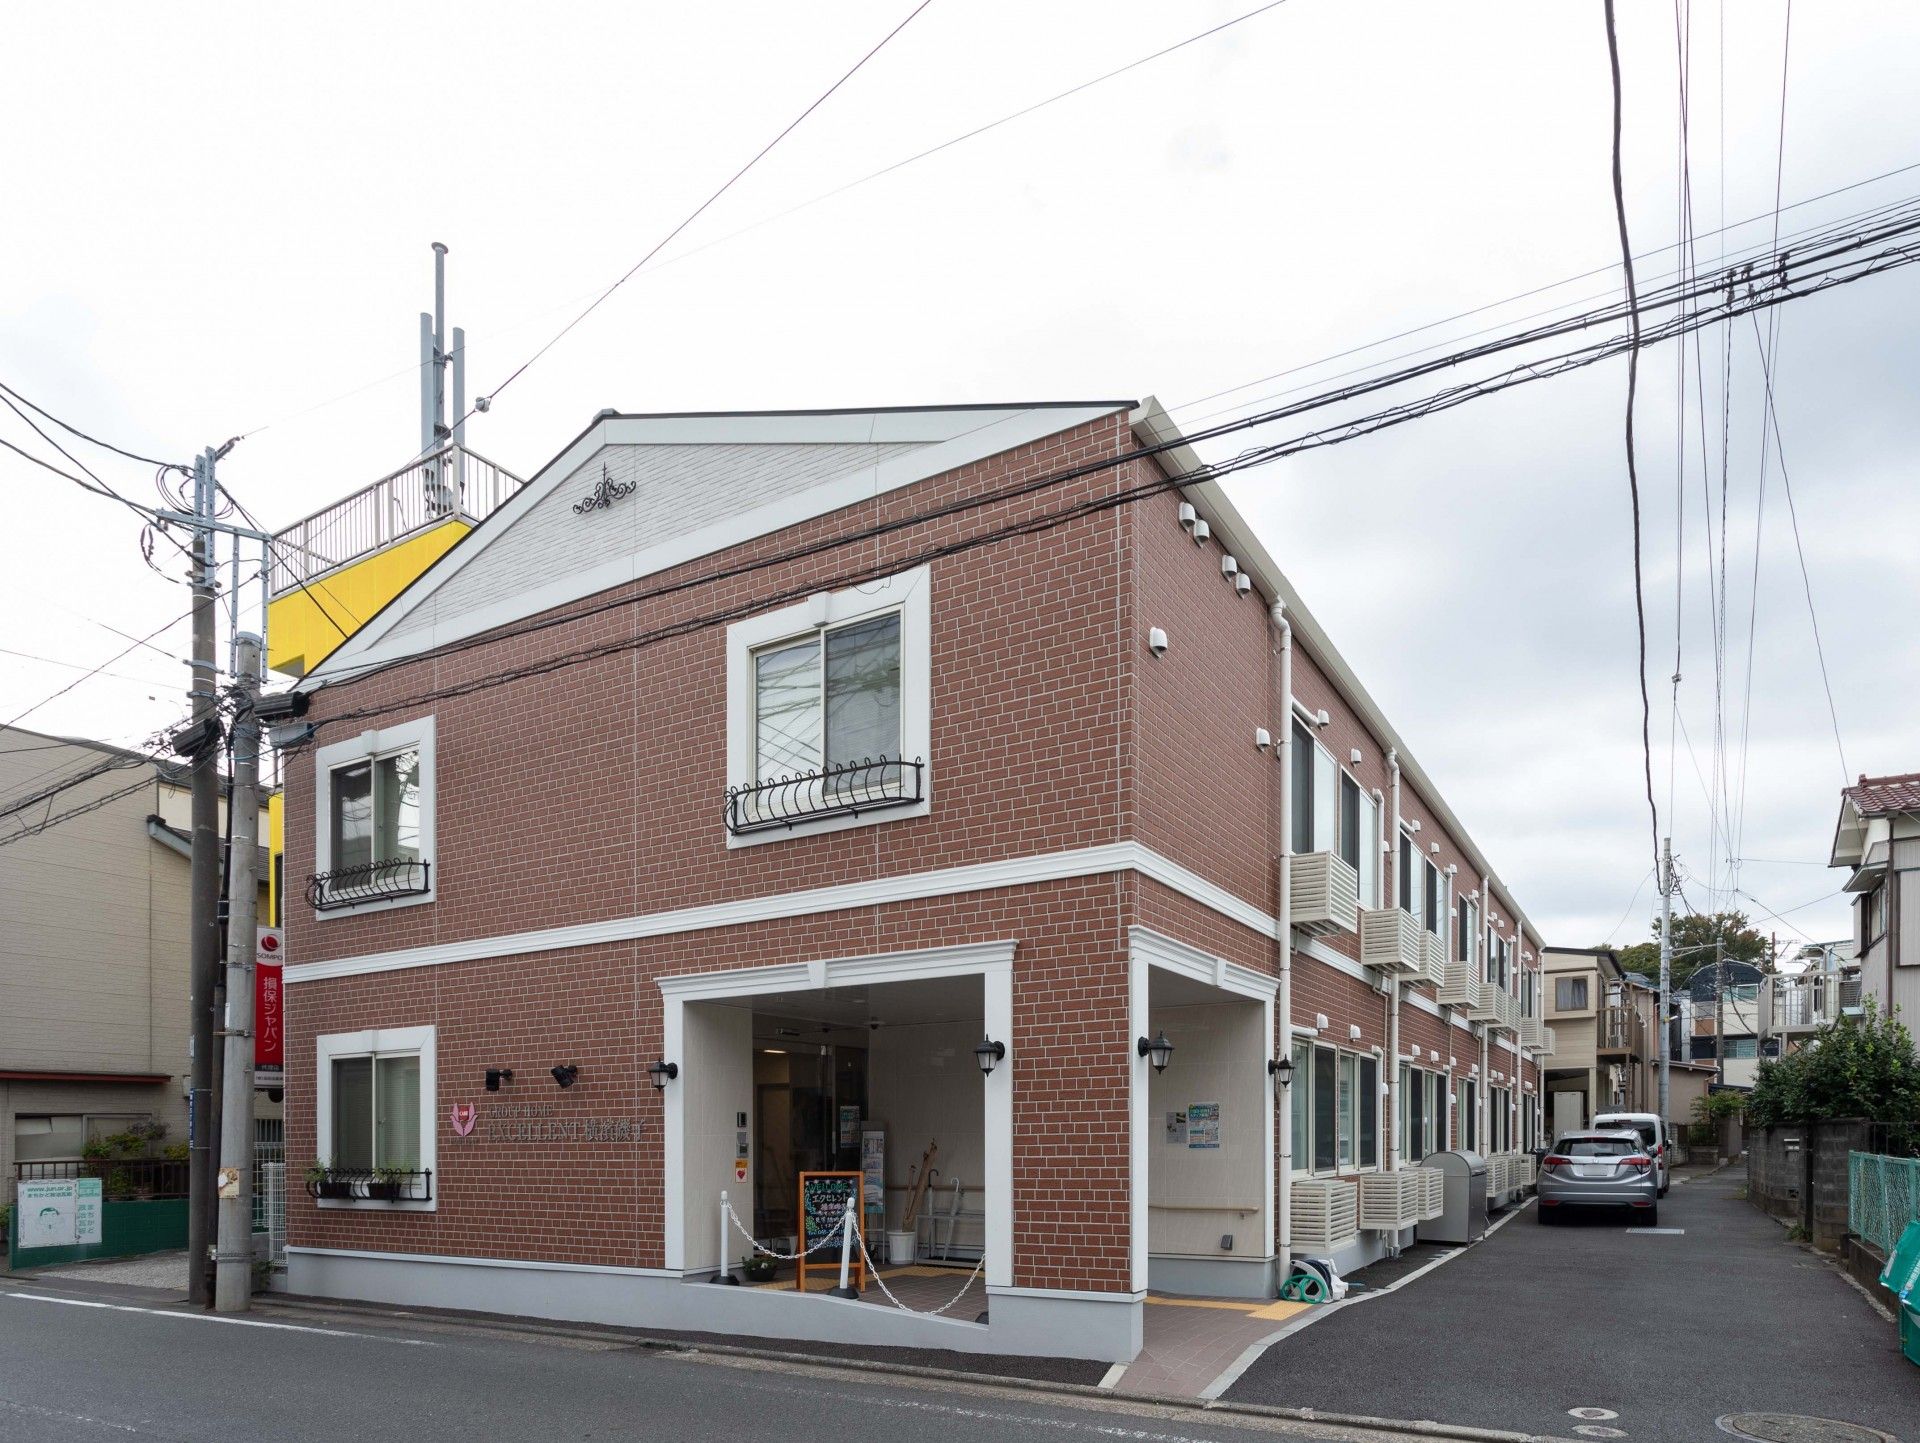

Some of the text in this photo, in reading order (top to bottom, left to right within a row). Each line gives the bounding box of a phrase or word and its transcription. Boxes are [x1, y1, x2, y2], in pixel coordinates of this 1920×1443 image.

[257, 953, 283, 961] SOMPO
[263, 976, 278, 1052] 損保ジャパン
[489, 1104, 553, 1118] GROUP HOME
[488, 1121, 580, 1141] EXCELLENT
[808, 1183, 848, 1191] WELCOME
[812, 1193, 849, 1203] エクセレント
